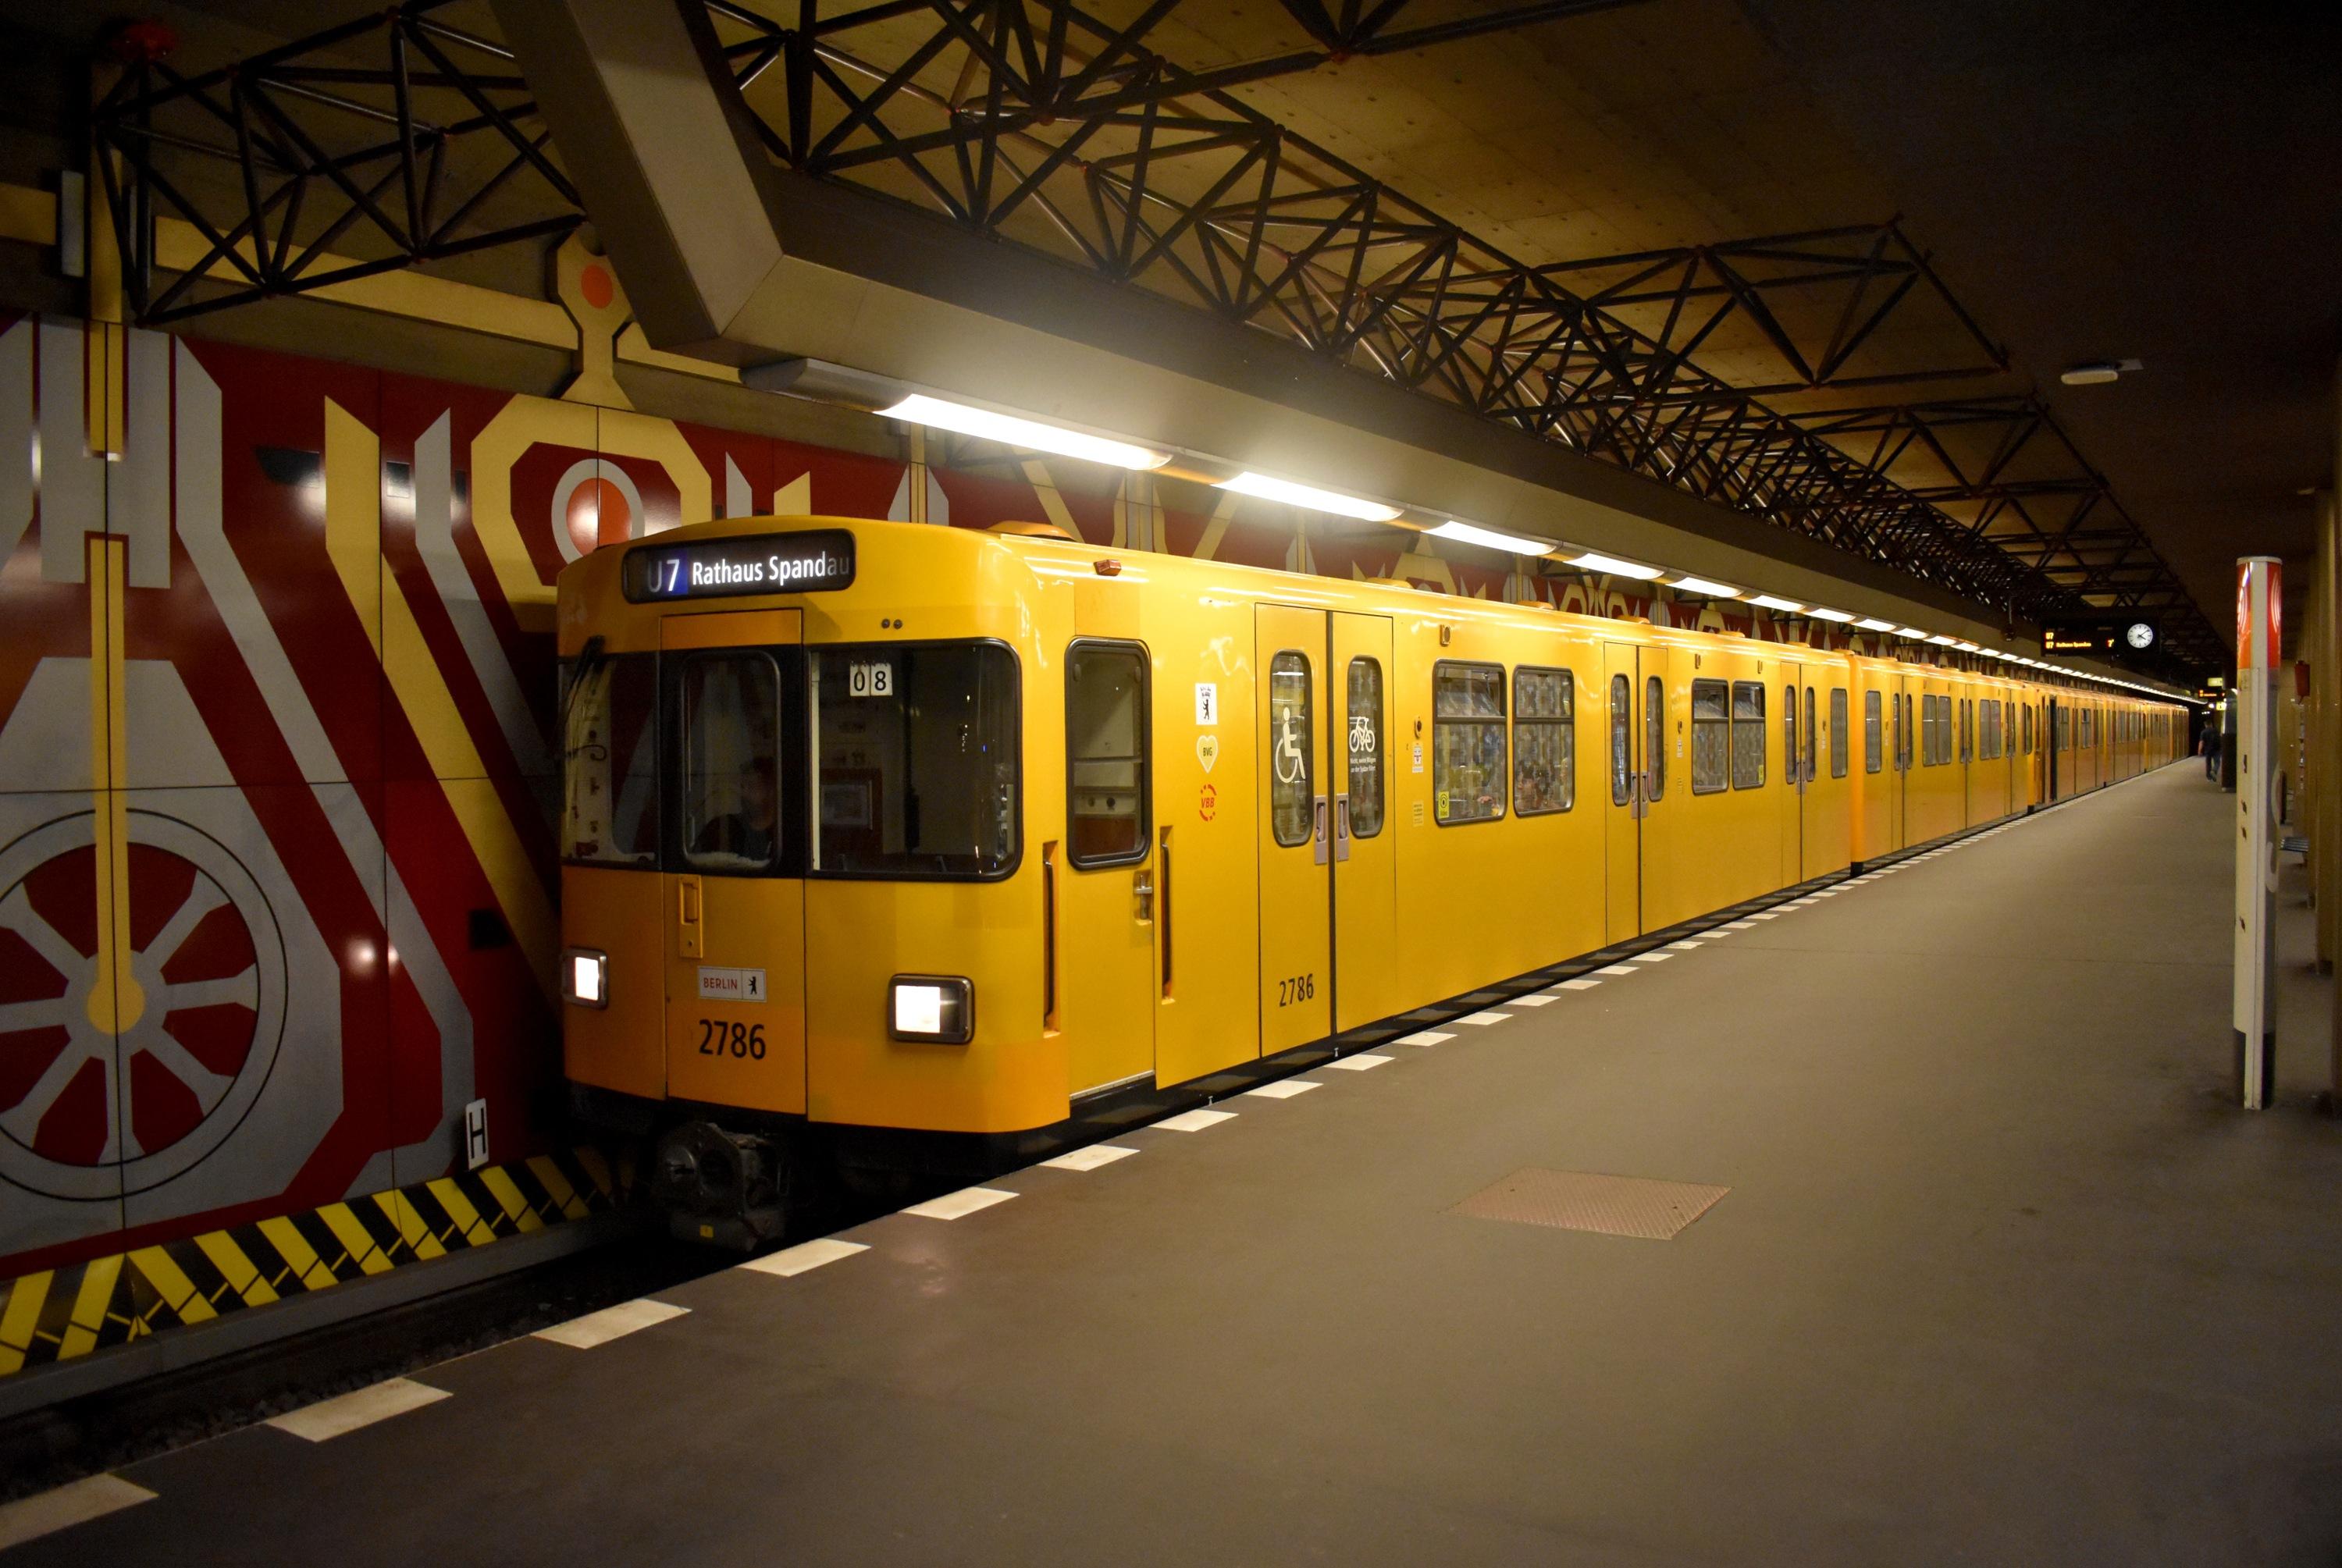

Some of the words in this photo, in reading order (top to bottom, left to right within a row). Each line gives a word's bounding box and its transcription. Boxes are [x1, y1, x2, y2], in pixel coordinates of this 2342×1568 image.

[646, 558, 680, 592] U7
[692, 559, 763, 585] Rathaus
[769, 551, 849, 586] Spandau
[1203, 747, 1212, 756] BVG
[1201, 798, 1215, 809] VBB
[703, 977, 738, 990] BERLIN
[1280, 972, 1314, 1008] 2786
[699, 1019, 767, 1061] 2786
[469, 1108, 486, 1159] H
